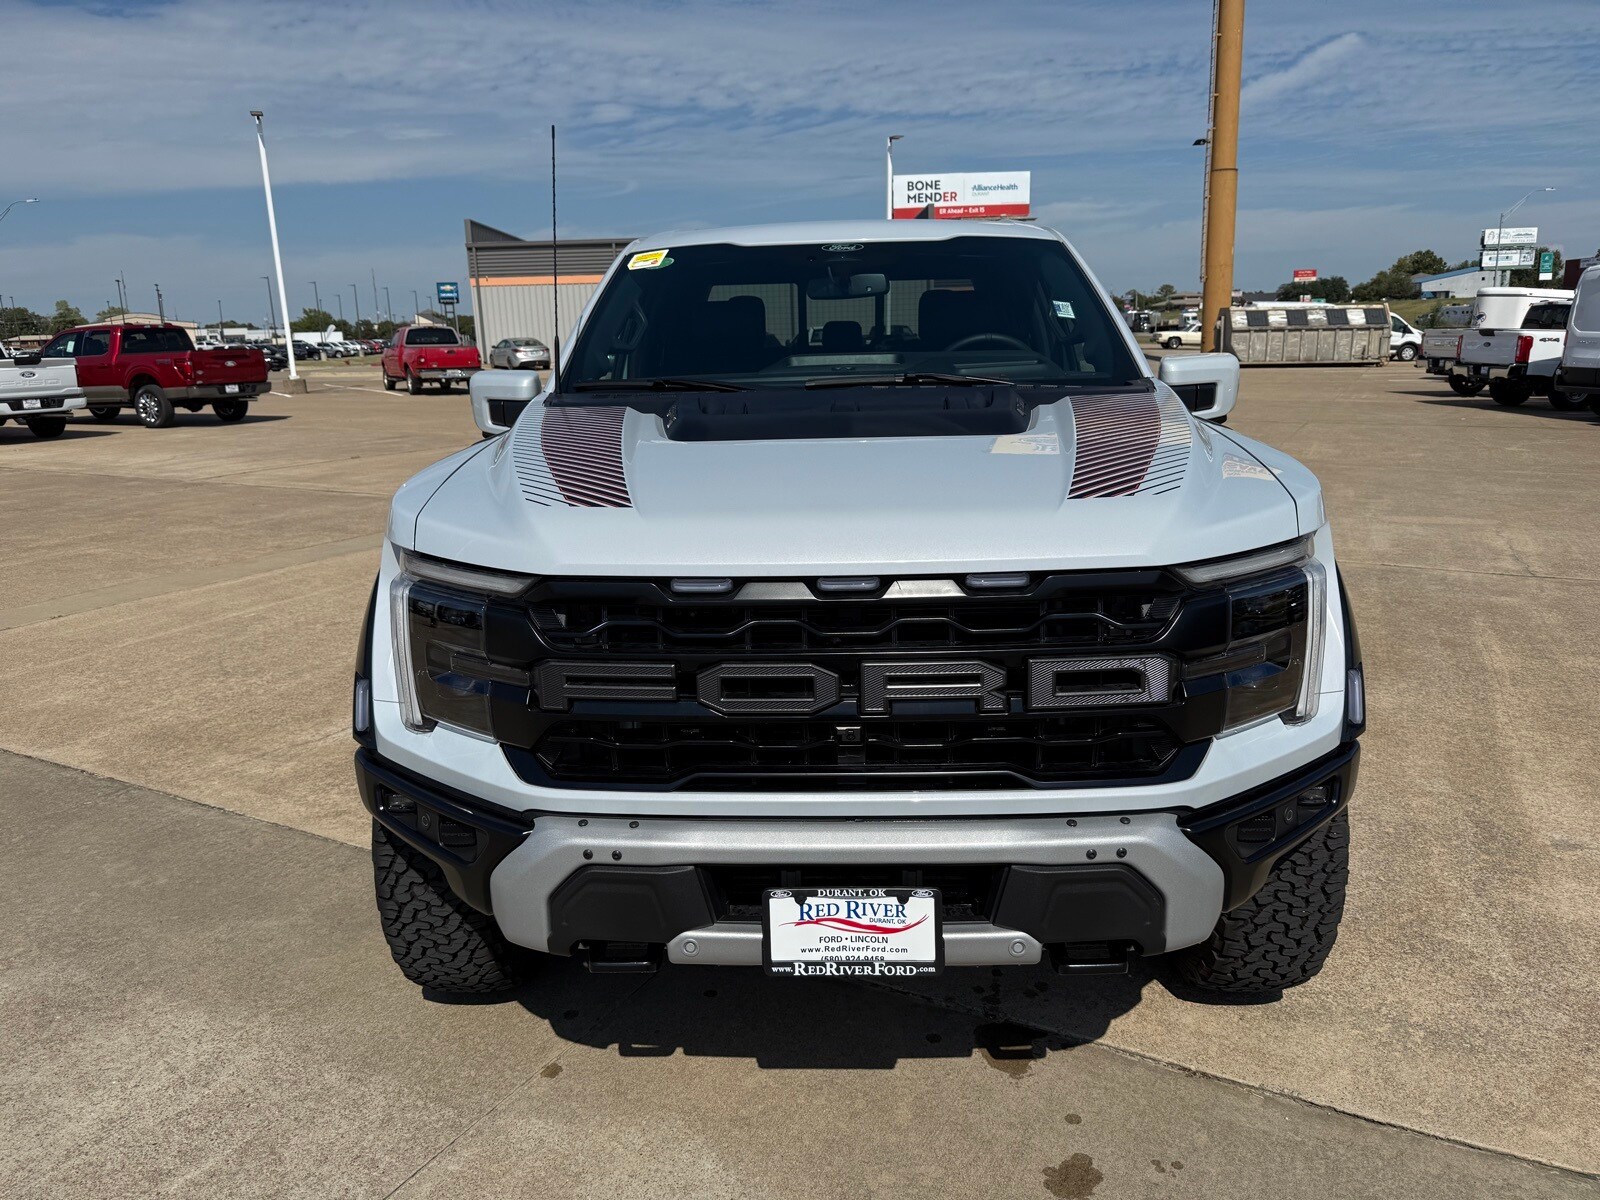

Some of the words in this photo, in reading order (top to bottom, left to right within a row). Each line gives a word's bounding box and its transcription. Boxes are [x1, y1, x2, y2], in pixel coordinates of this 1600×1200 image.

[907, 180, 941, 191] BONE
[971, 182, 1019, 191] AllianceHealth
[907, 191, 958, 203] MENDER
[535, 657, 1174, 718] FORD
[817, 889, 867, 898] DURANT,
[869, 889, 887, 897] OK
[869, 917, 896, 925] DURANT,
[819, 936, 843, 944] FORD
[850, 936, 889, 944] LINCOLN
[800, 945, 908, 953] www.RedRiverFord.com
